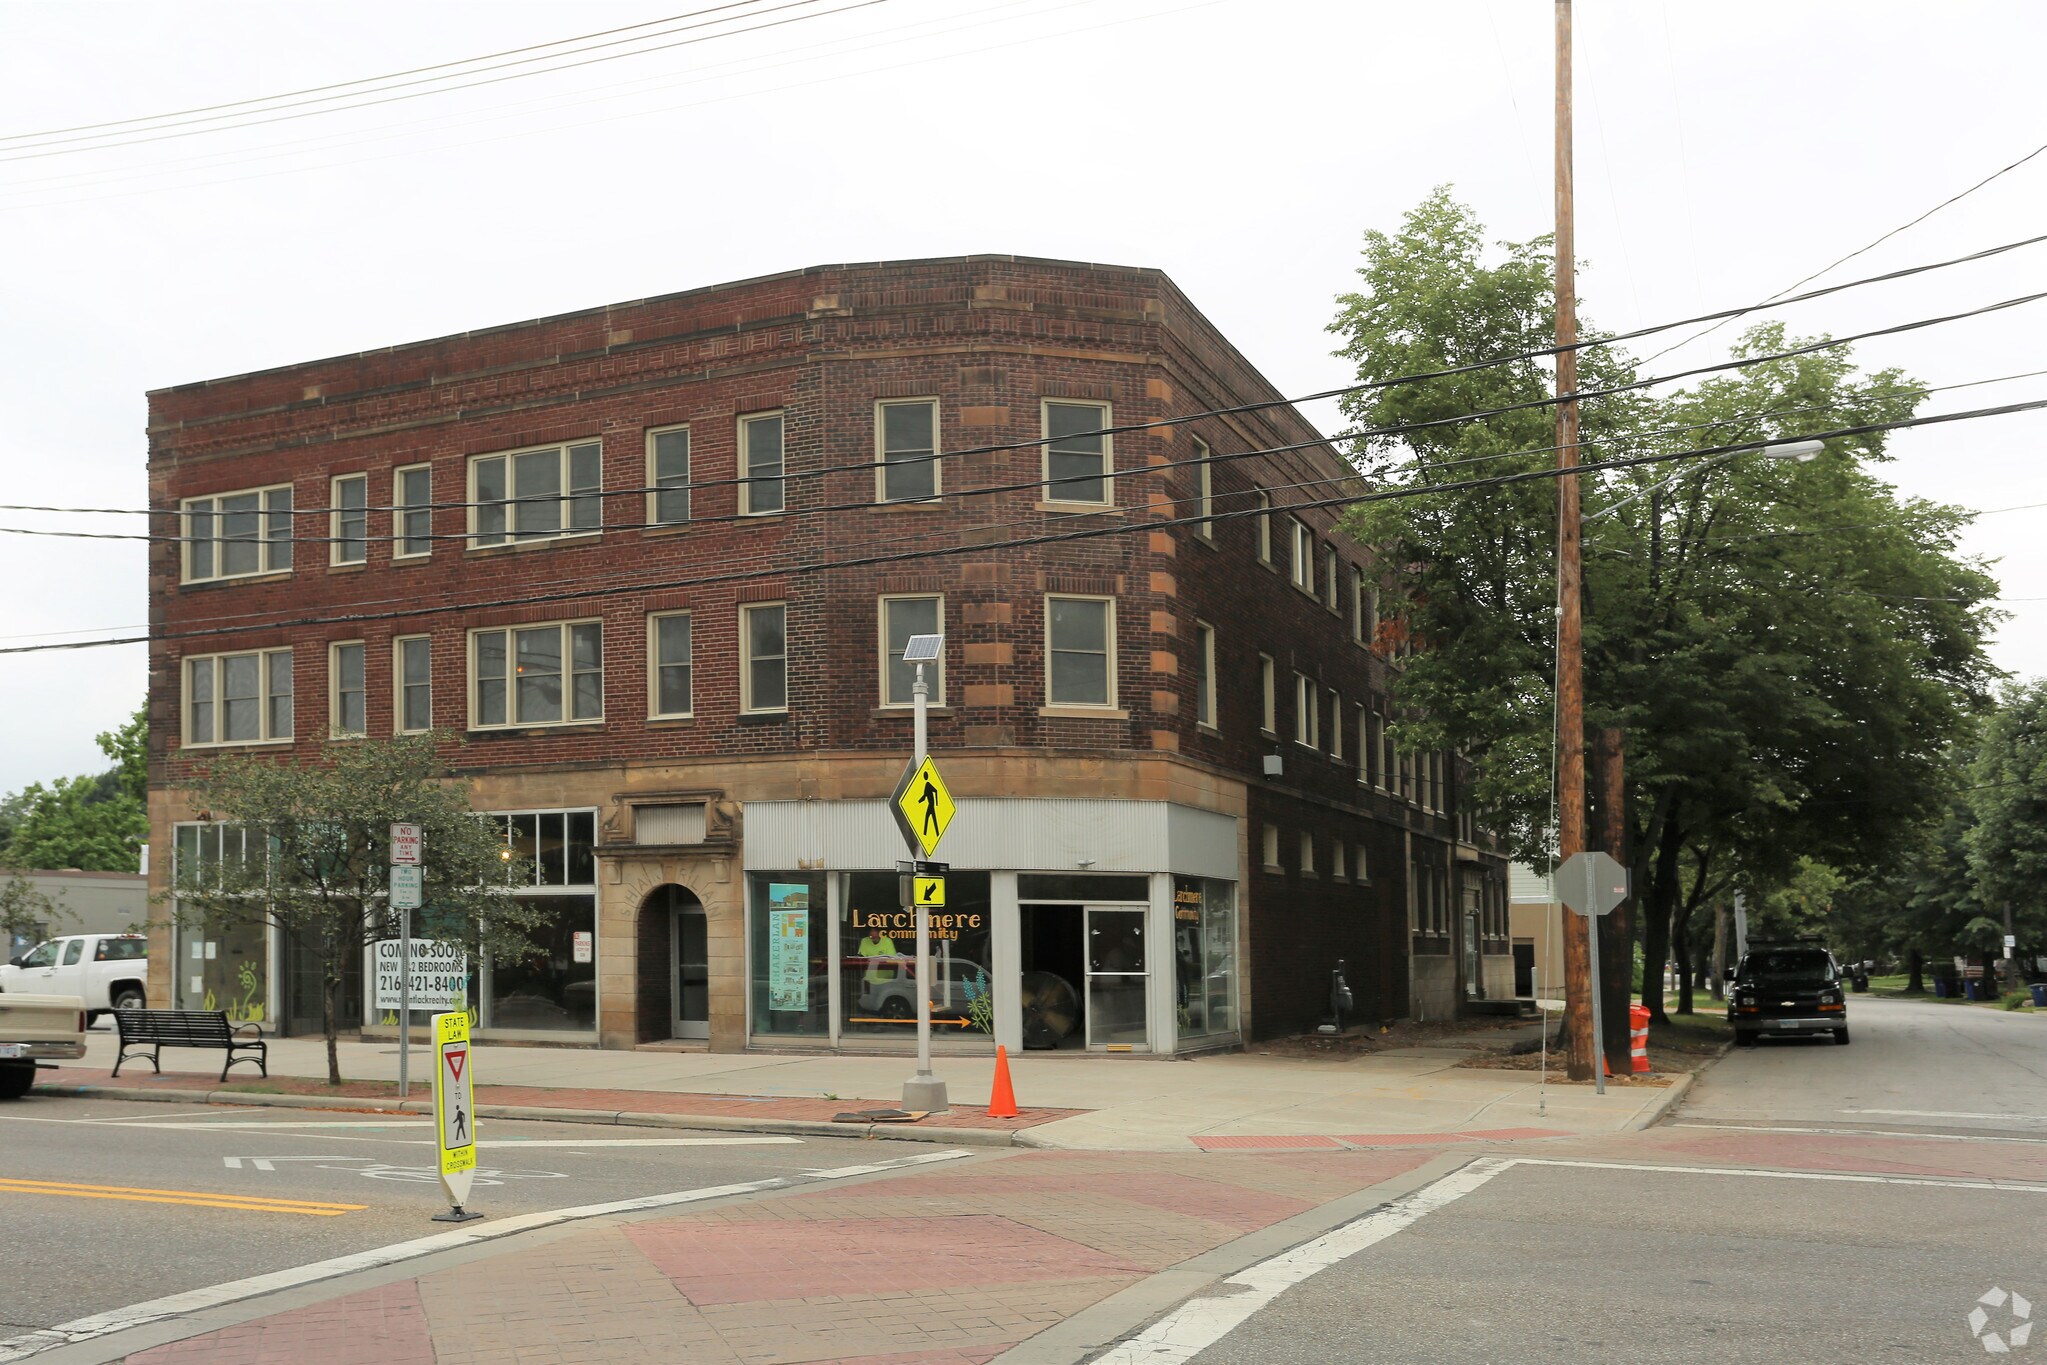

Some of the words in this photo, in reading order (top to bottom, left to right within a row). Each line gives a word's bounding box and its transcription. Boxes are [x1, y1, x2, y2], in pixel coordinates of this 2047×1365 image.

[400, 827, 412, 835] NO
[393, 836, 419, 844] PARKING
[879, 928, 958, 941] commnity
[380, 943, 428, 958] COMNG
[380, 961, 398, 972] NEW
[418, 961, 464, 973] BEDROOMS
[380, 975, 464, 991] 216421-8400
[444, 1016, 464, 1029] STATE
[448, 1030, 462, 1040] LAW
[454, 1091, 462, 1100] TO
